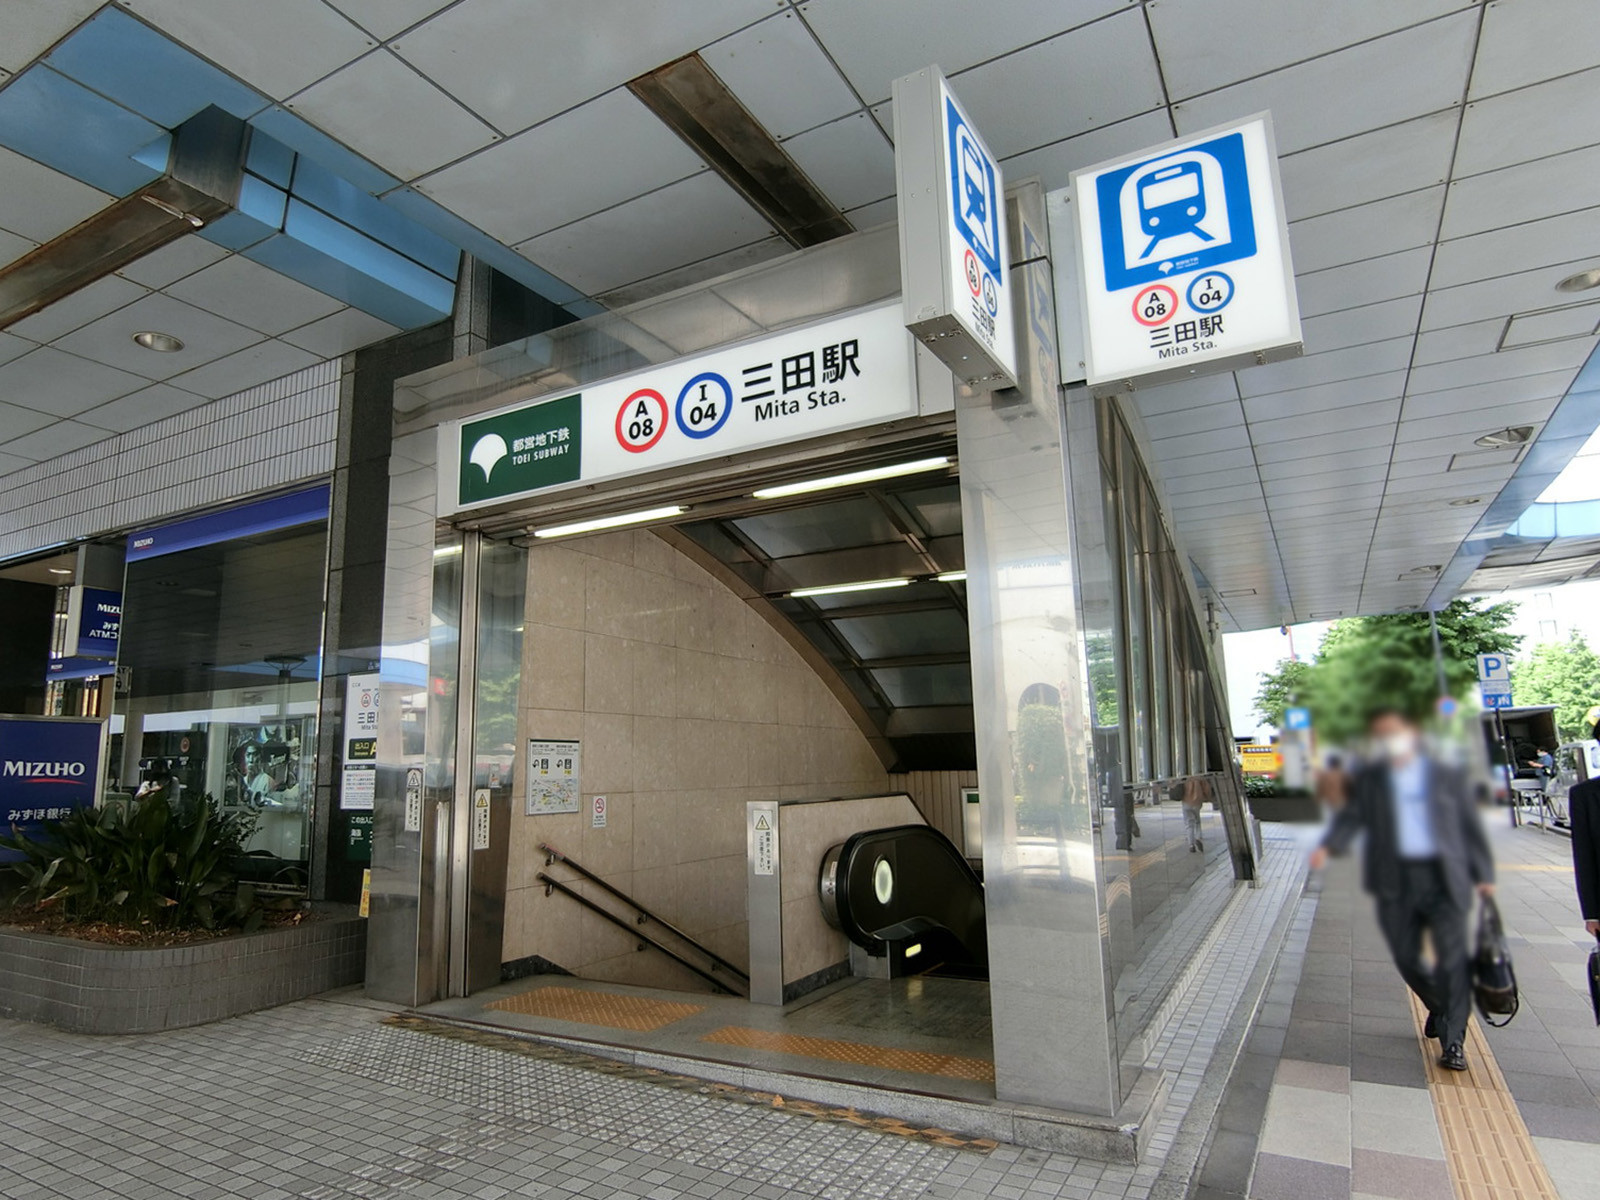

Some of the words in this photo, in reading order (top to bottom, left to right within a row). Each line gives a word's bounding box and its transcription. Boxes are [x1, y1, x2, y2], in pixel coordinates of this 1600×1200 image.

[1205, 278, 1214, 290] I
[1149, 292, 1161, 304] A
[1199, 290, 1223, 306] 04
[1144, 303, 1167, 318] 08
[1149, 314, 1225, 349] 三田駅
[1158, 345, 1189, 360] Mita
[1192, 340, 1218, 353] Sta.
[740, 338, 861, 403] 三田駅
[699, 383, 708, 402] I
[635, 400, 649, 418] A
[689, 403, 717, 425] 04
[754, 400, 800, 422] Mita
[807, 389, 847, 411] Sta.
[628, 418, 654, 440] 08
[512, 427, 570, 453] 都営地下鉄
[512, 453, 531, 466] TOEI
[533, 444, 570, 461] SUBWAY
[1483, 657, 1501, 677] P
[357, 711, 379, 724] 三田
[3, 761, 86, 777] MIZUHO
[8, 807, 72, 821] みずほ銀行
